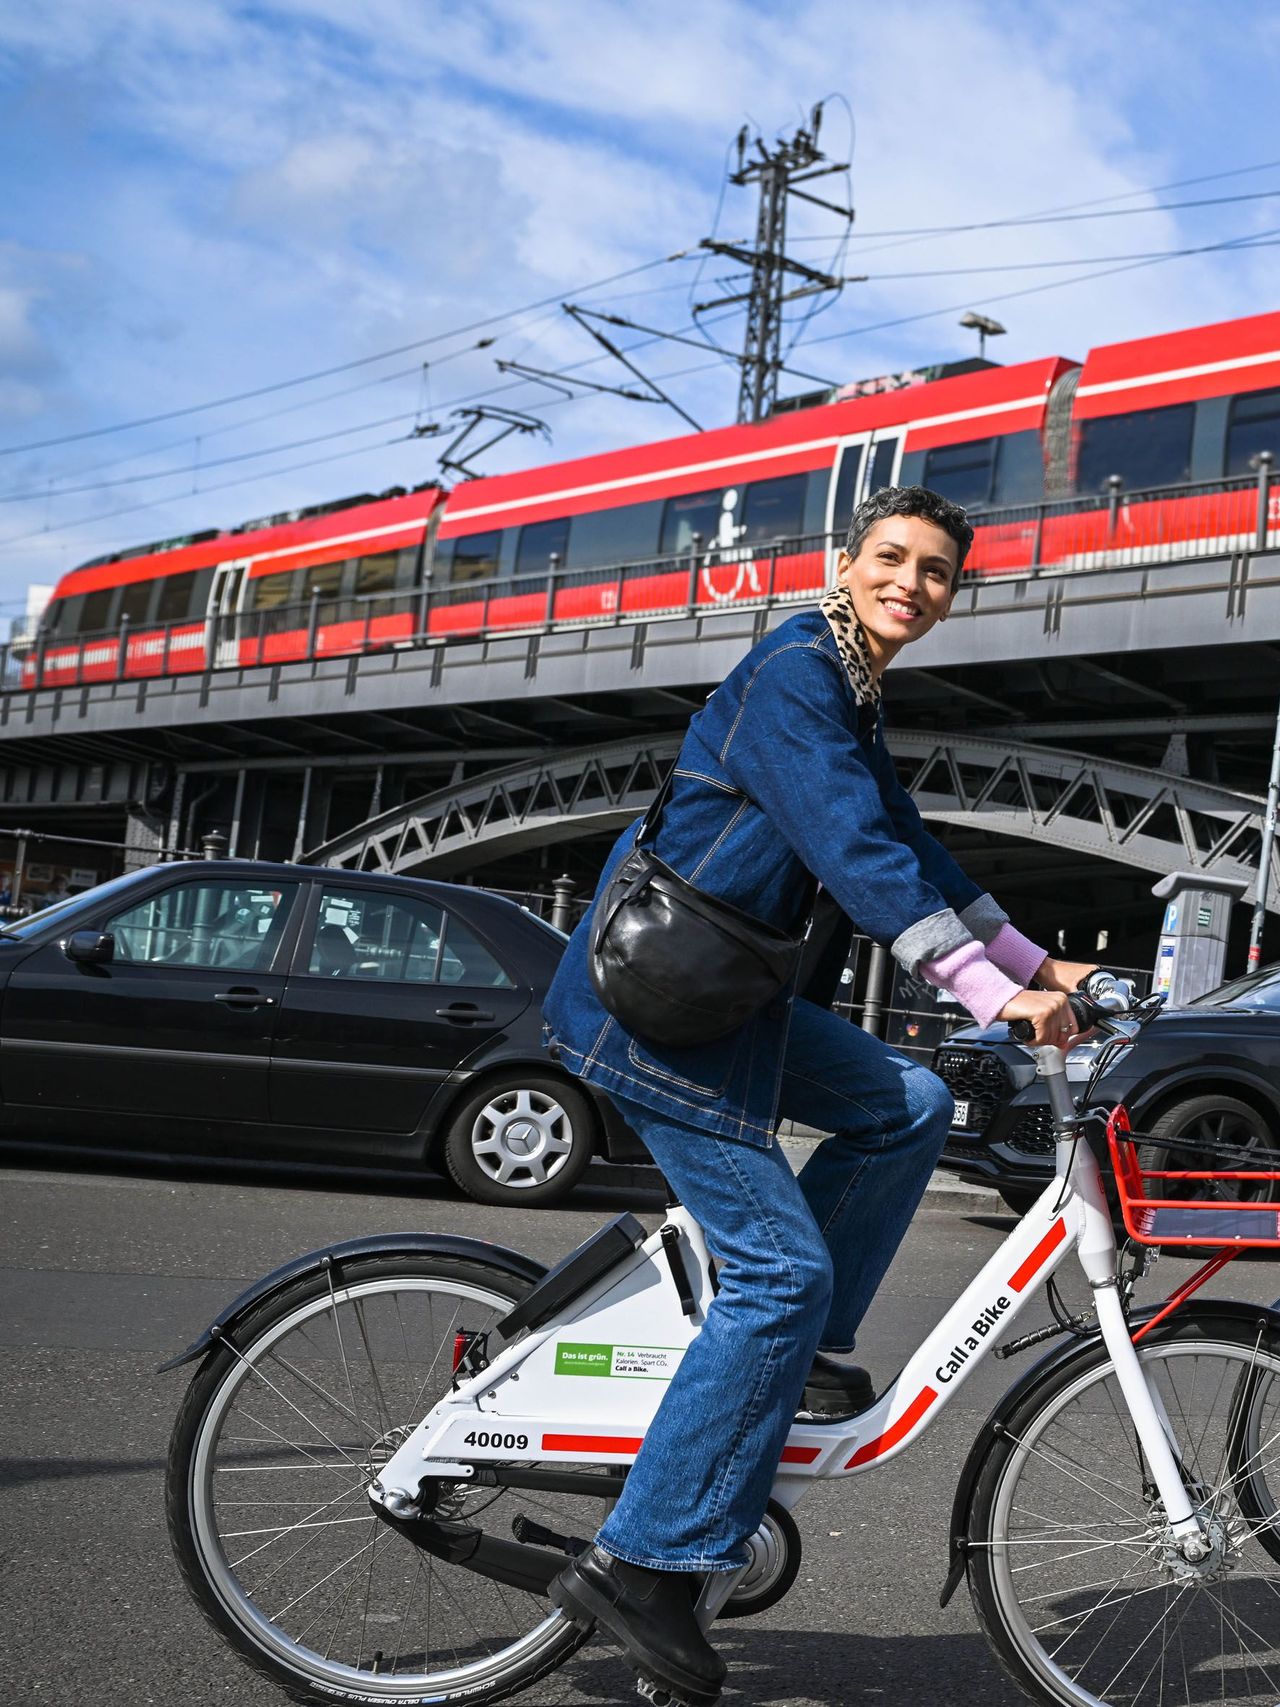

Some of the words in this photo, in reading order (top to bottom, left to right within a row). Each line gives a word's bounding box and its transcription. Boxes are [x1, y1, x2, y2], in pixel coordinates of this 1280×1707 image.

[1166, 904, 1177, 931] P
[971, 1296, 1011, 1338] Bike
[964, 1336, 980, 1351] a
[562, 1352, 576, 1360] Das
[577, 1352, 587, 1360] ist
[588, 1352, 609, 1361] grün.
[935, 1345, 970, 1383] Call
[463, 1431, 529, 1450] 40009
[347, 1693, 367, 1702] PLUS
[449, 1680, 497, 1699] SCHWALBE
[367, 1696, 397, 1705] CRUISER
